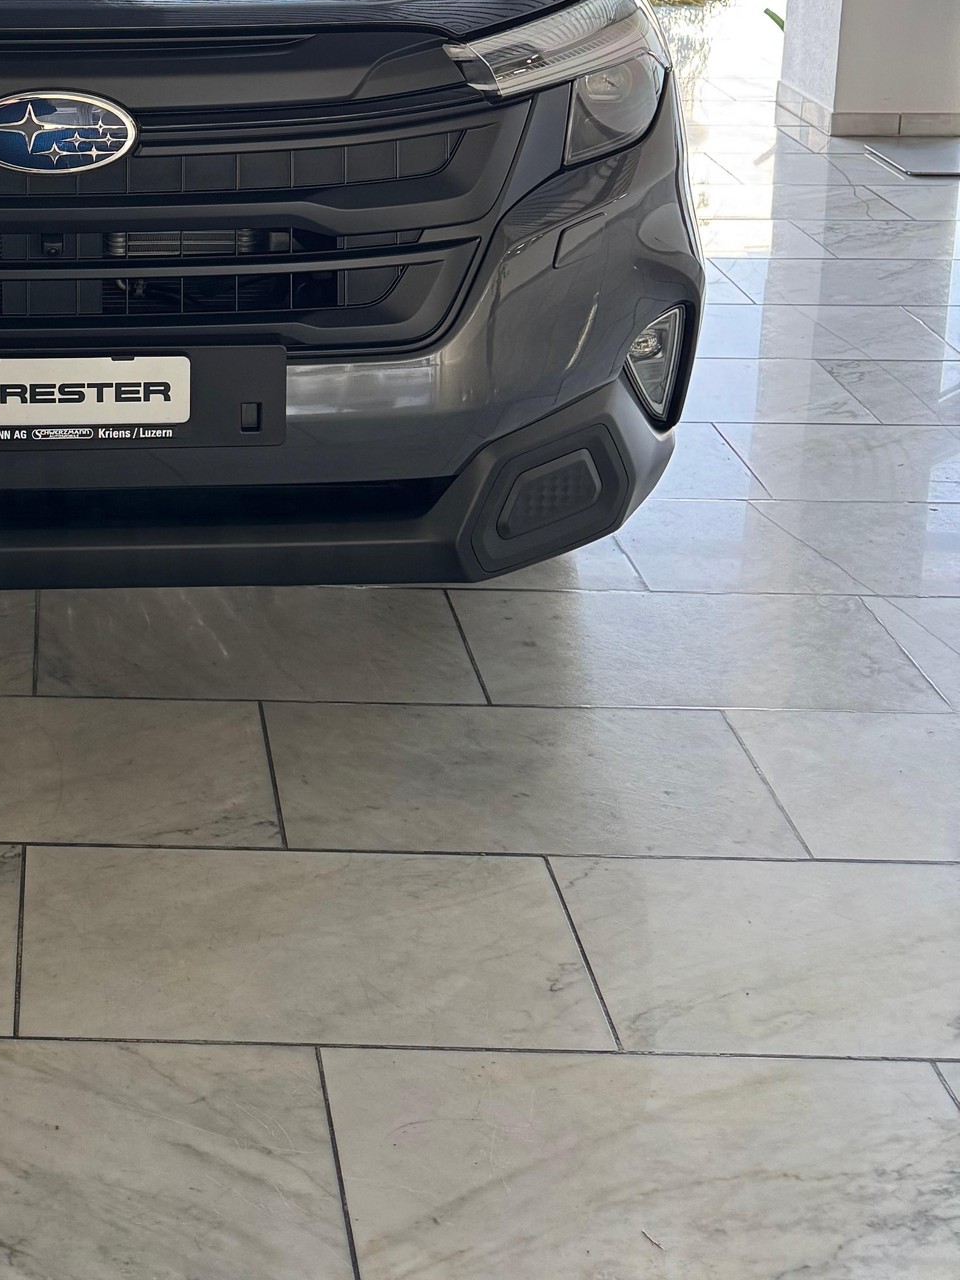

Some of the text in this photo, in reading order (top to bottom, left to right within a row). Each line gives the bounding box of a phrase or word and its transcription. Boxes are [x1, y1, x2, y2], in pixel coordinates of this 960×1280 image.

[13, 431, 27, 440] AG
[98, 428, 131, 439] Kriens
[139, 427, 173, 438] Luzern
